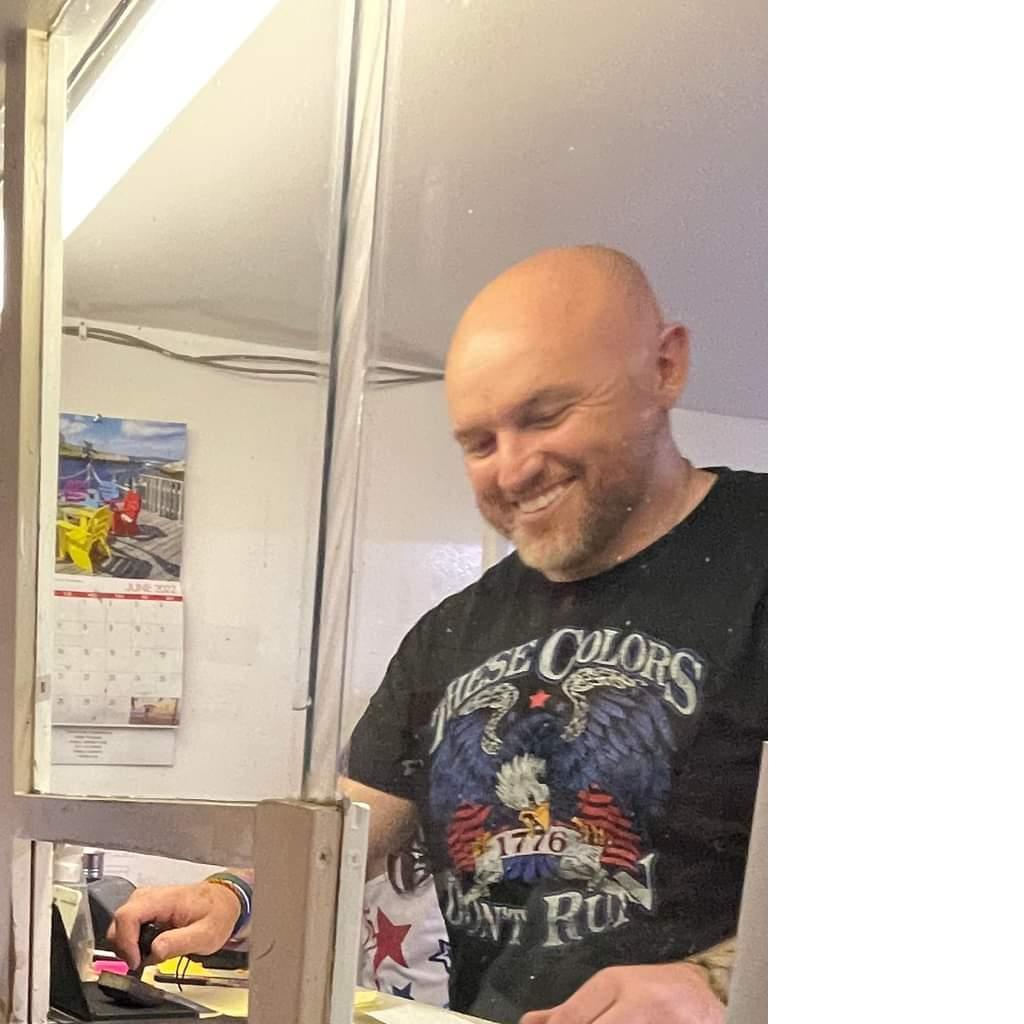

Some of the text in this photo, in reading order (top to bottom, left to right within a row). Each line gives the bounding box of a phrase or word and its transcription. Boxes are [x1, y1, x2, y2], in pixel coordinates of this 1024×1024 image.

[429, 627, 704, 754] THESE COLORS
[498, 829, 567, 856] 1776
[542, 853, 657, 948] RUN
